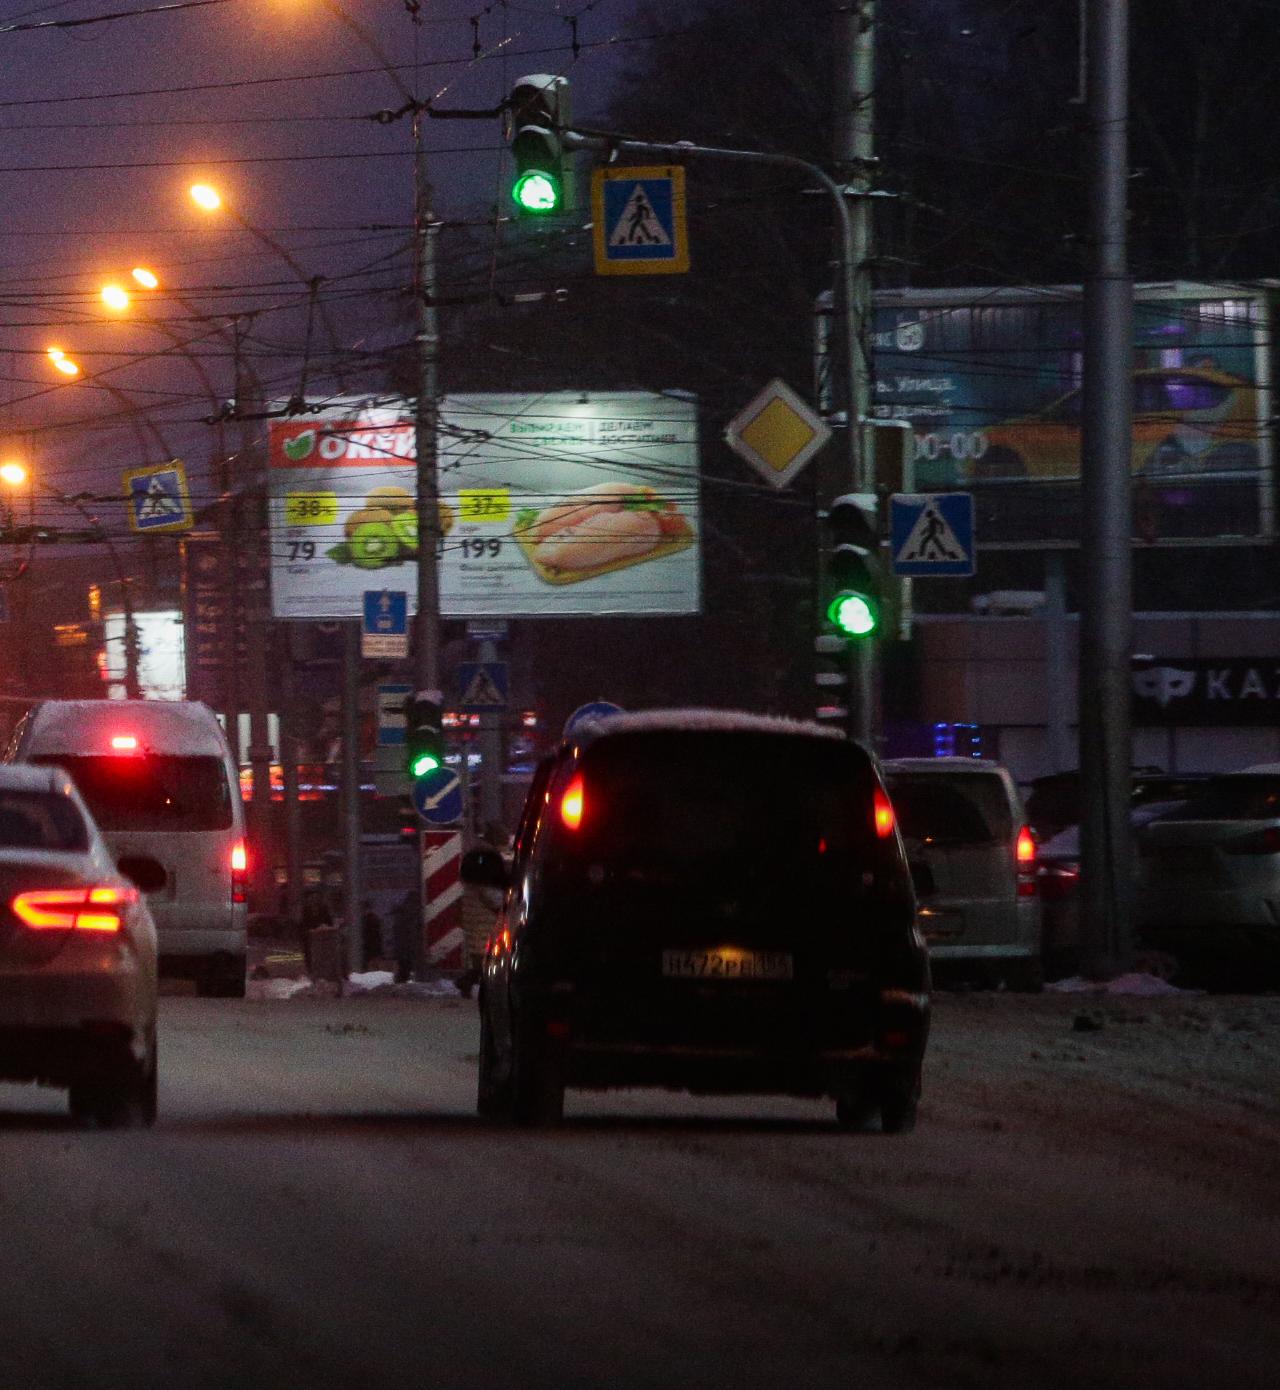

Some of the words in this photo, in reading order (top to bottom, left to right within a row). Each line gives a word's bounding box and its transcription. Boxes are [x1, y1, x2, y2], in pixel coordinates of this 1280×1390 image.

[288, 541, 315, 561] 79
[461, 538, 501, 558] 199
[1207, 668, 1280, 699] КА
